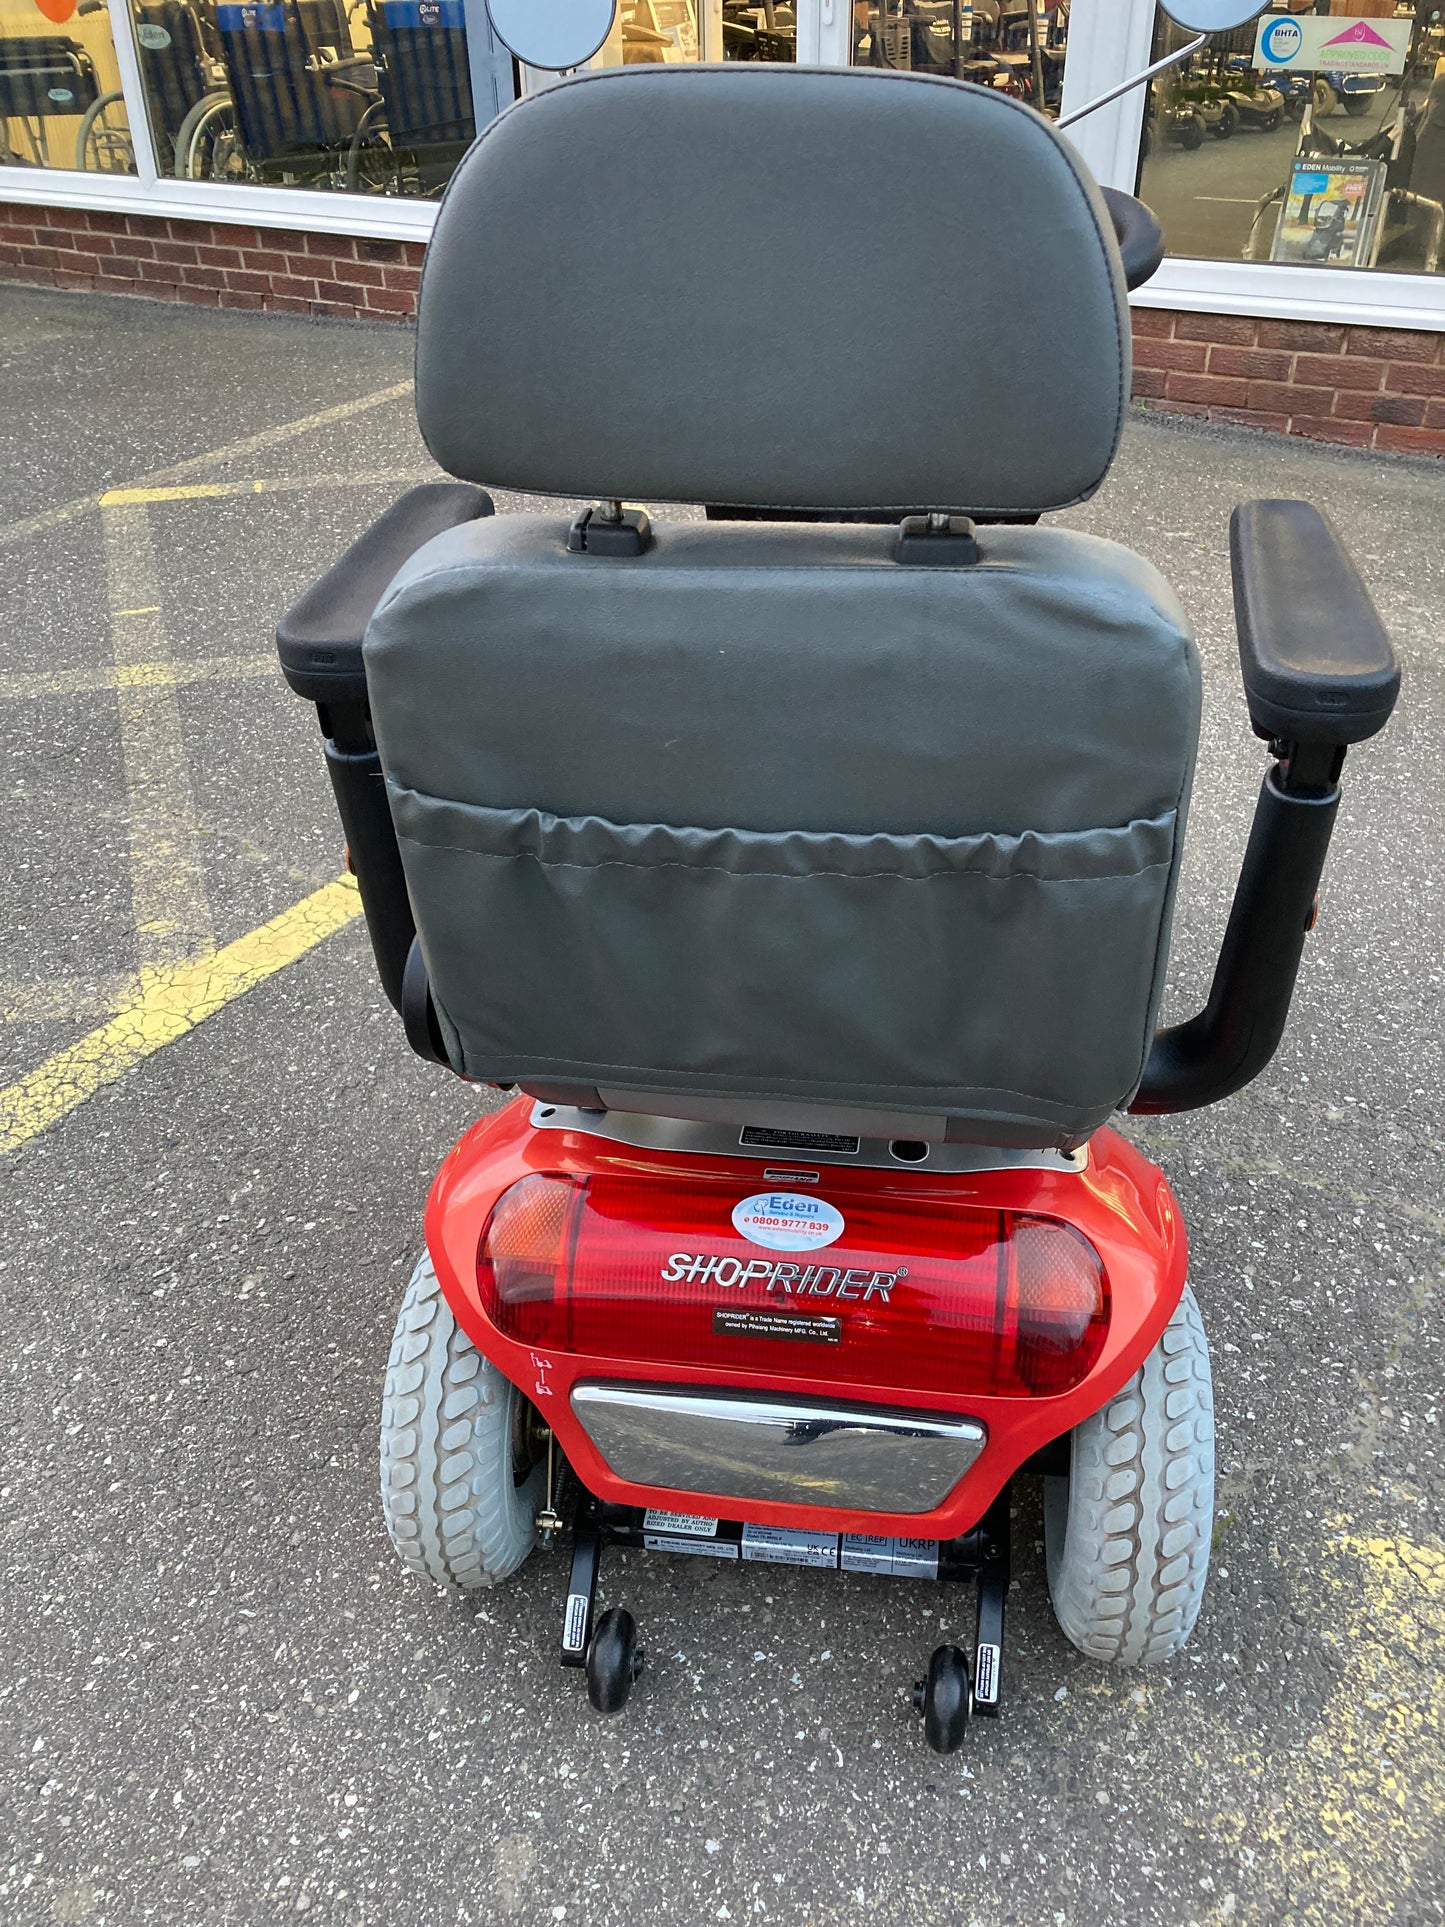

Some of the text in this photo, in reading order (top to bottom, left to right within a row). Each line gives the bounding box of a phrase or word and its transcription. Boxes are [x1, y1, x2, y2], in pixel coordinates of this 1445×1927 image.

[1274, 29, 1298, 37] BHTA
[1302, 163, 1321, 171] EDEN
[1322, 164, 1346, 173] Mobility
[769, 1196, 819, 1213] Eden
[752, 1216, 829, 1231] 0800 9777 839
[647, 1515, 681, 1523] ADJUSTED
[668, 1523, 692, 1531] DEALER
[851, 1533, 936, 1550] EC REP UKRP
